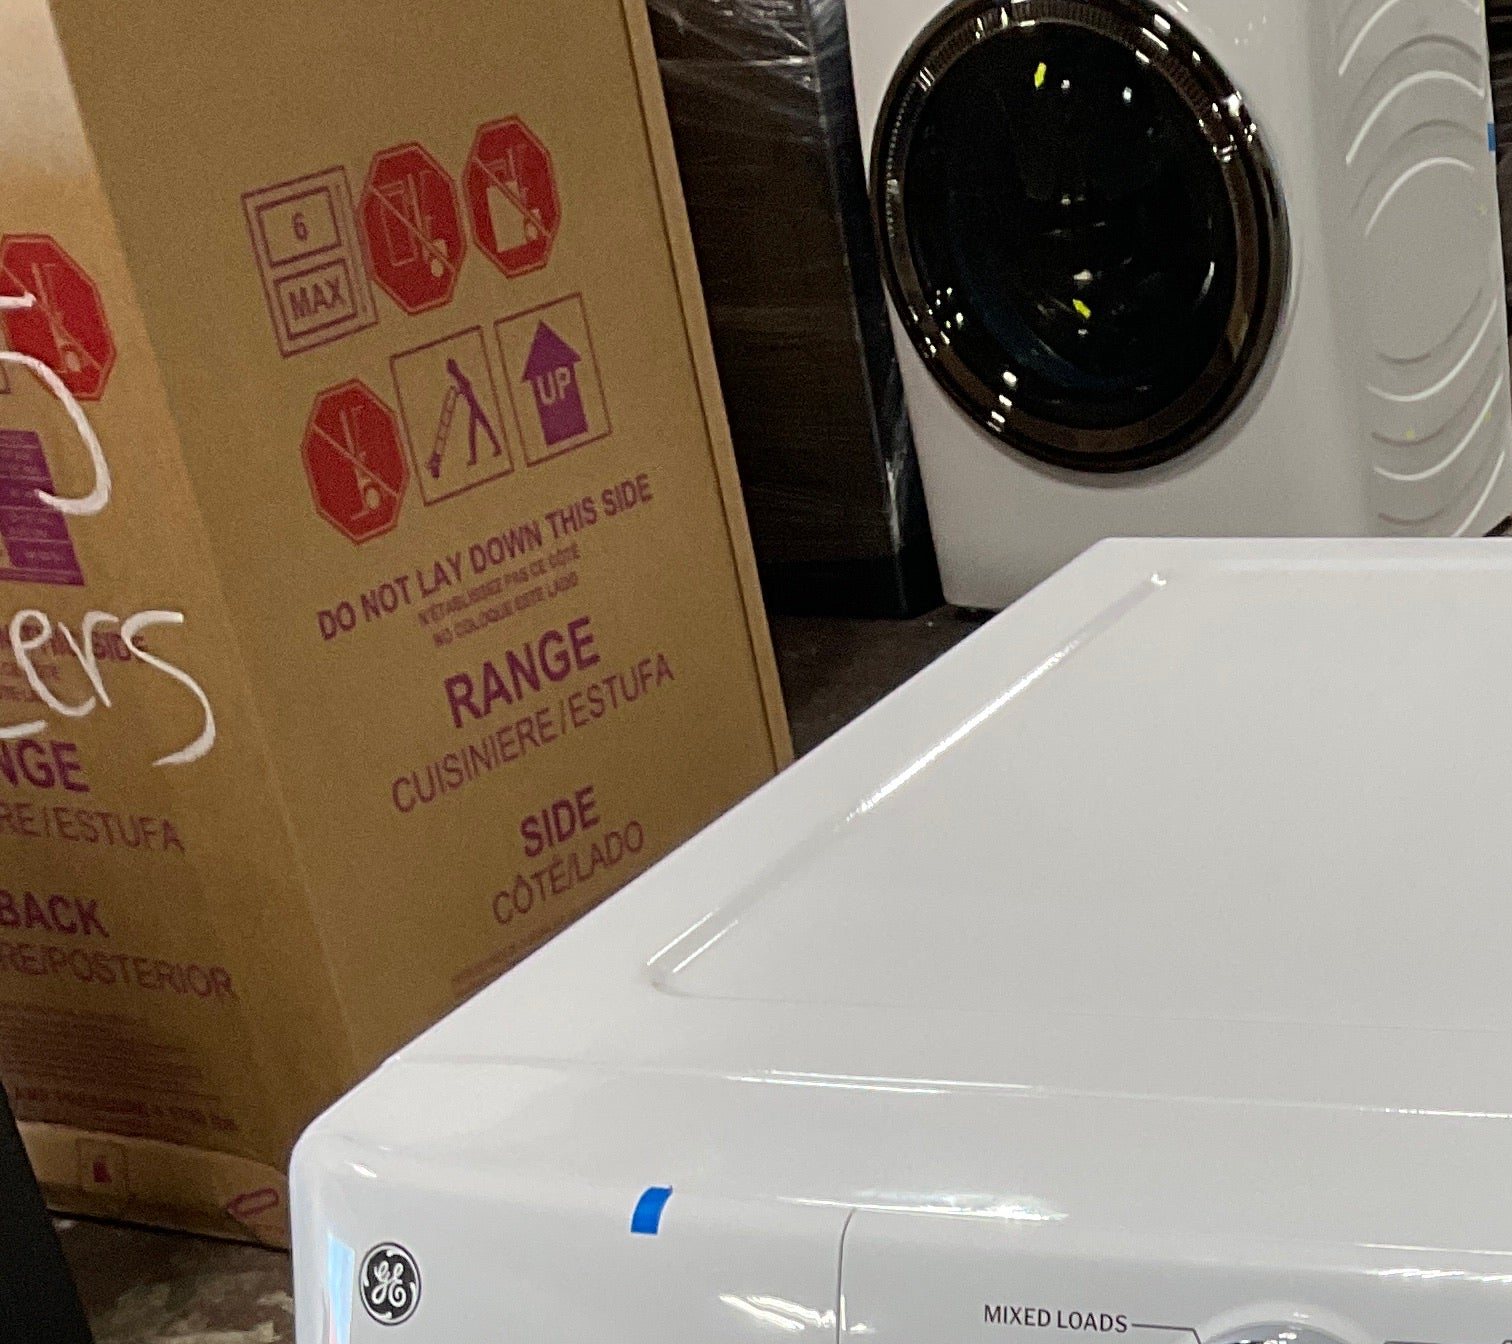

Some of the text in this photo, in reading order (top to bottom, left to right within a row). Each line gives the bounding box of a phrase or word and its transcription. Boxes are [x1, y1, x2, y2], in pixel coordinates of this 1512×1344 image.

[291, 211, 310, 242] 6
[288, 278, 346, 320] MAX
[536, 366, 572, 405] UP
[316, 473, 655, 642] DO NOT LAY DOWN THIS SIDE
[444, 615, 600, 729] RANGE
[519, 784, 600, 858] SIDE
[0, 889, 110, 938] BACK
[983, 1303, 1128, 1333] MIXED LOADS
